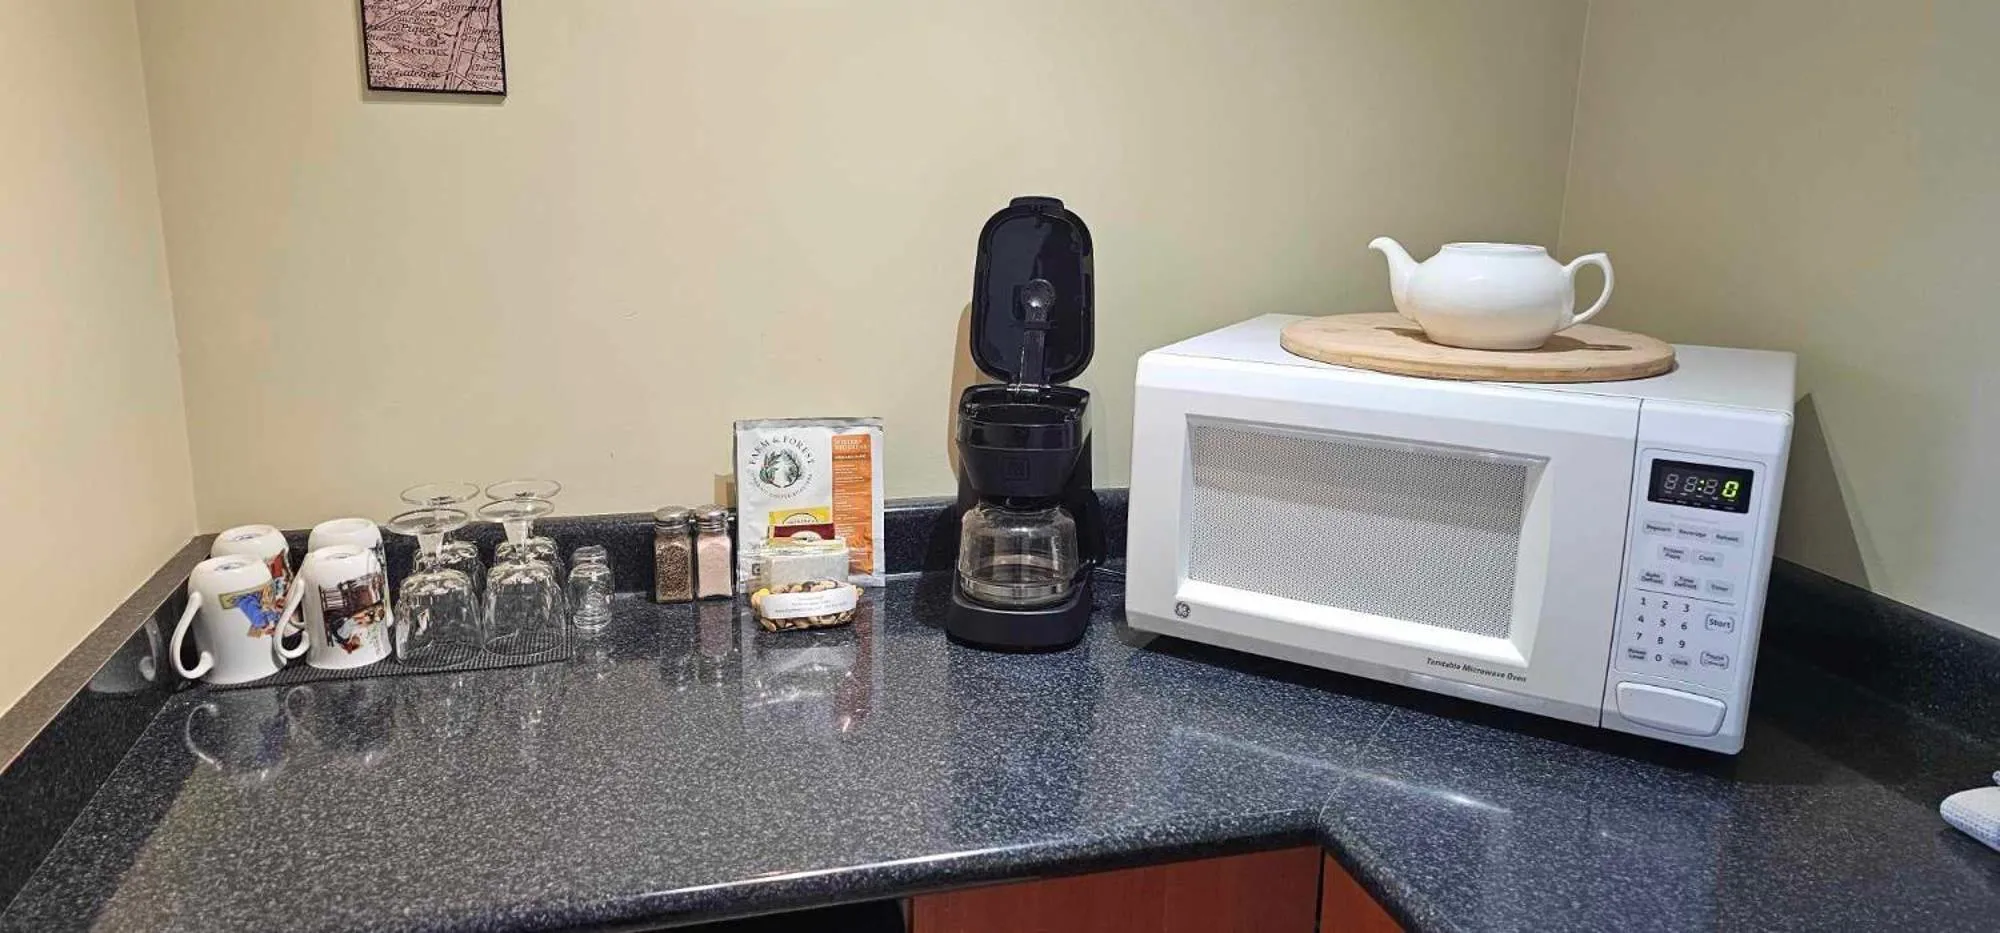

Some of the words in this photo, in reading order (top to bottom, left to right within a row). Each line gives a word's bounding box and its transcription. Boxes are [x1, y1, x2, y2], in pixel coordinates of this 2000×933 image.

[749, 440, 770, 465] FARM
[783, 435, 816, 464] FOREST
[1641, 597, 1646, 606] 1
[1662, 601, 1668, 610] 2
[1683, 604, 1690, 613] 3
[1638, 615, 1644, 623] 4
[1660, 619, 1666, 627] 5
[1681, 622, 1688, 630] 6
[1708, 618, 1731, 629] Start
[1636, 632, 1643, 640] 7
[1657, 636, 1664, 645] 8
[1679, 640, 1686, 649] 9
[1655, 654, 1662, 662] 0
[1462, 664, 1506, 678] Microwave
[1507, 672, 1527, 683] Oven
